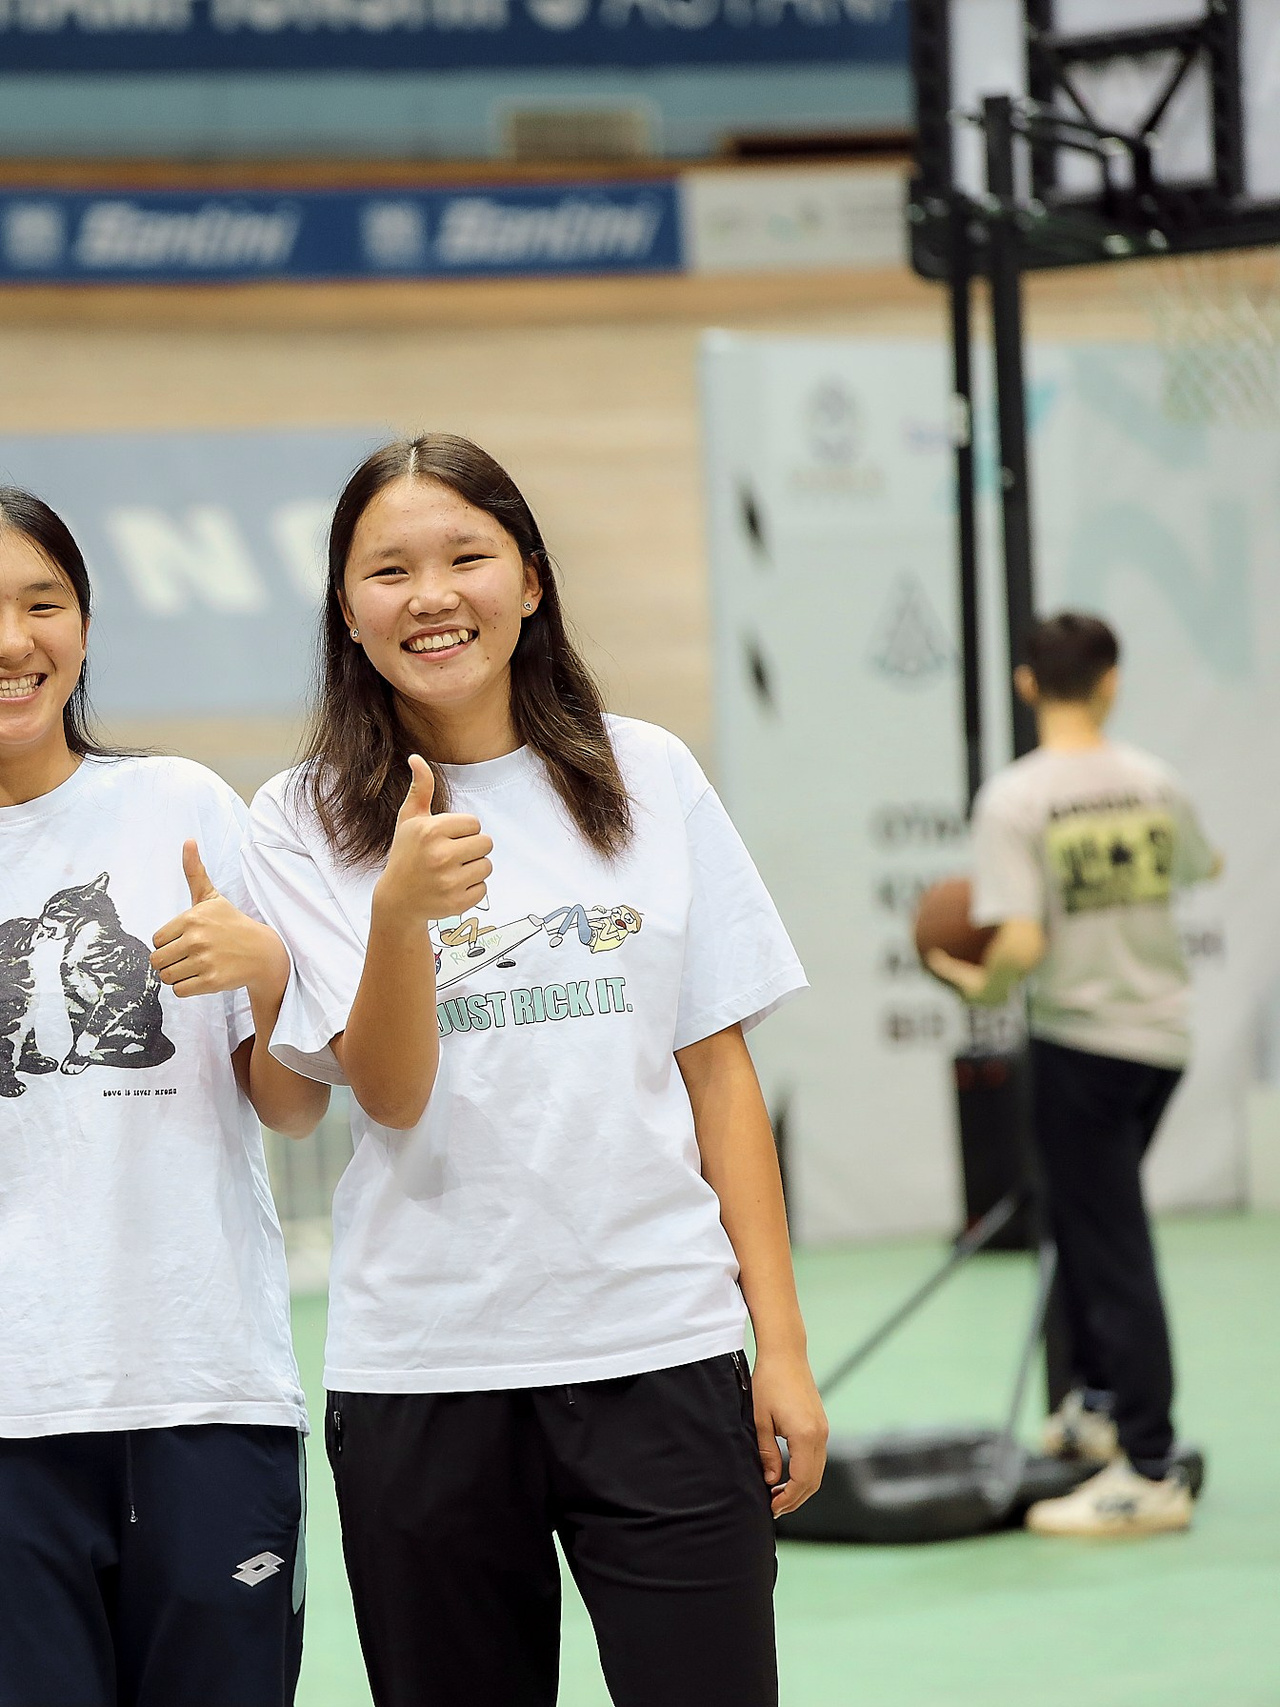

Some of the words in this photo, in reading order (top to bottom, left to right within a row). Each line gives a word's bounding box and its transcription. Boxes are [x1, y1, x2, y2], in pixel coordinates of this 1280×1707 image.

[436, 992, 506, 1037] JUST
[510, 980, 594, 1025] RICK
[595, 977, 634, 1013] IT.
